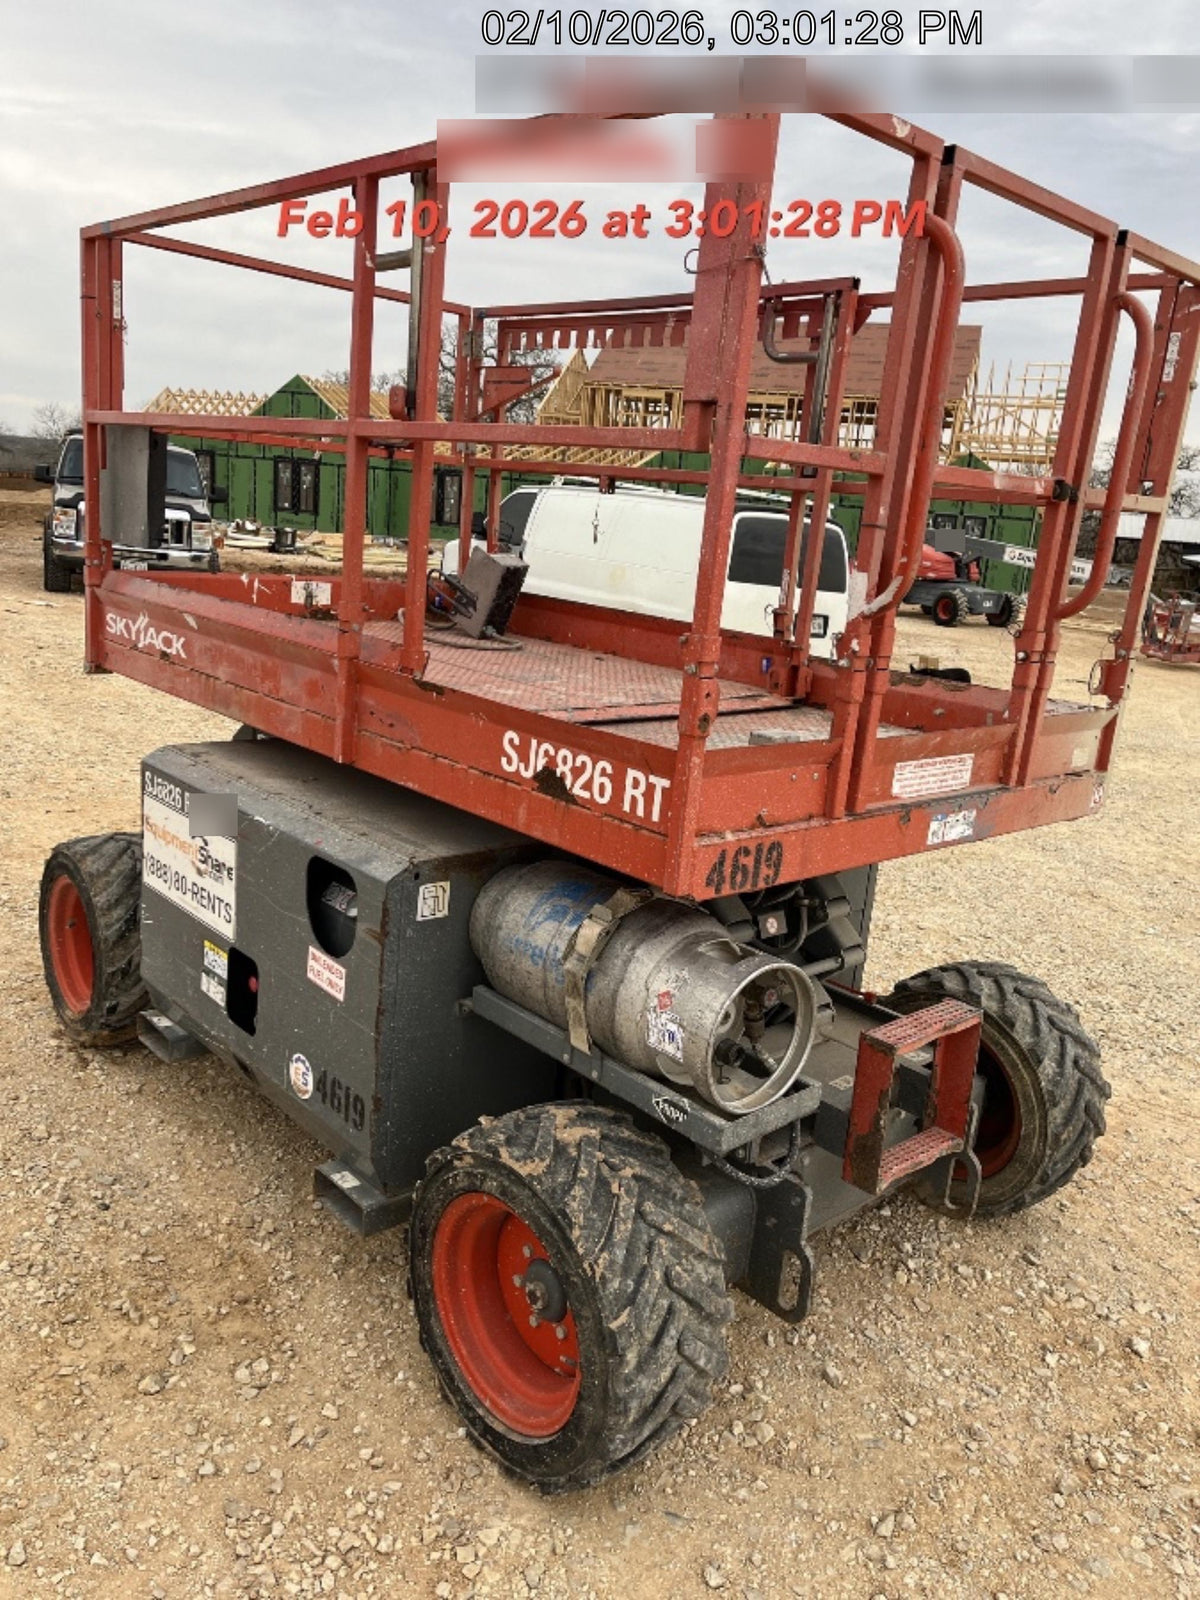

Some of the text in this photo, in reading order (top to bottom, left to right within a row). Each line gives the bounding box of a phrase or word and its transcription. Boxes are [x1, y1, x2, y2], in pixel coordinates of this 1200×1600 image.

[105, 611, 187, 660] SKYJACK
[622, 767, 671, 823] RT
[704, 839, 784, 895] 4619
[316, 1069, 366, 1132] 4619
